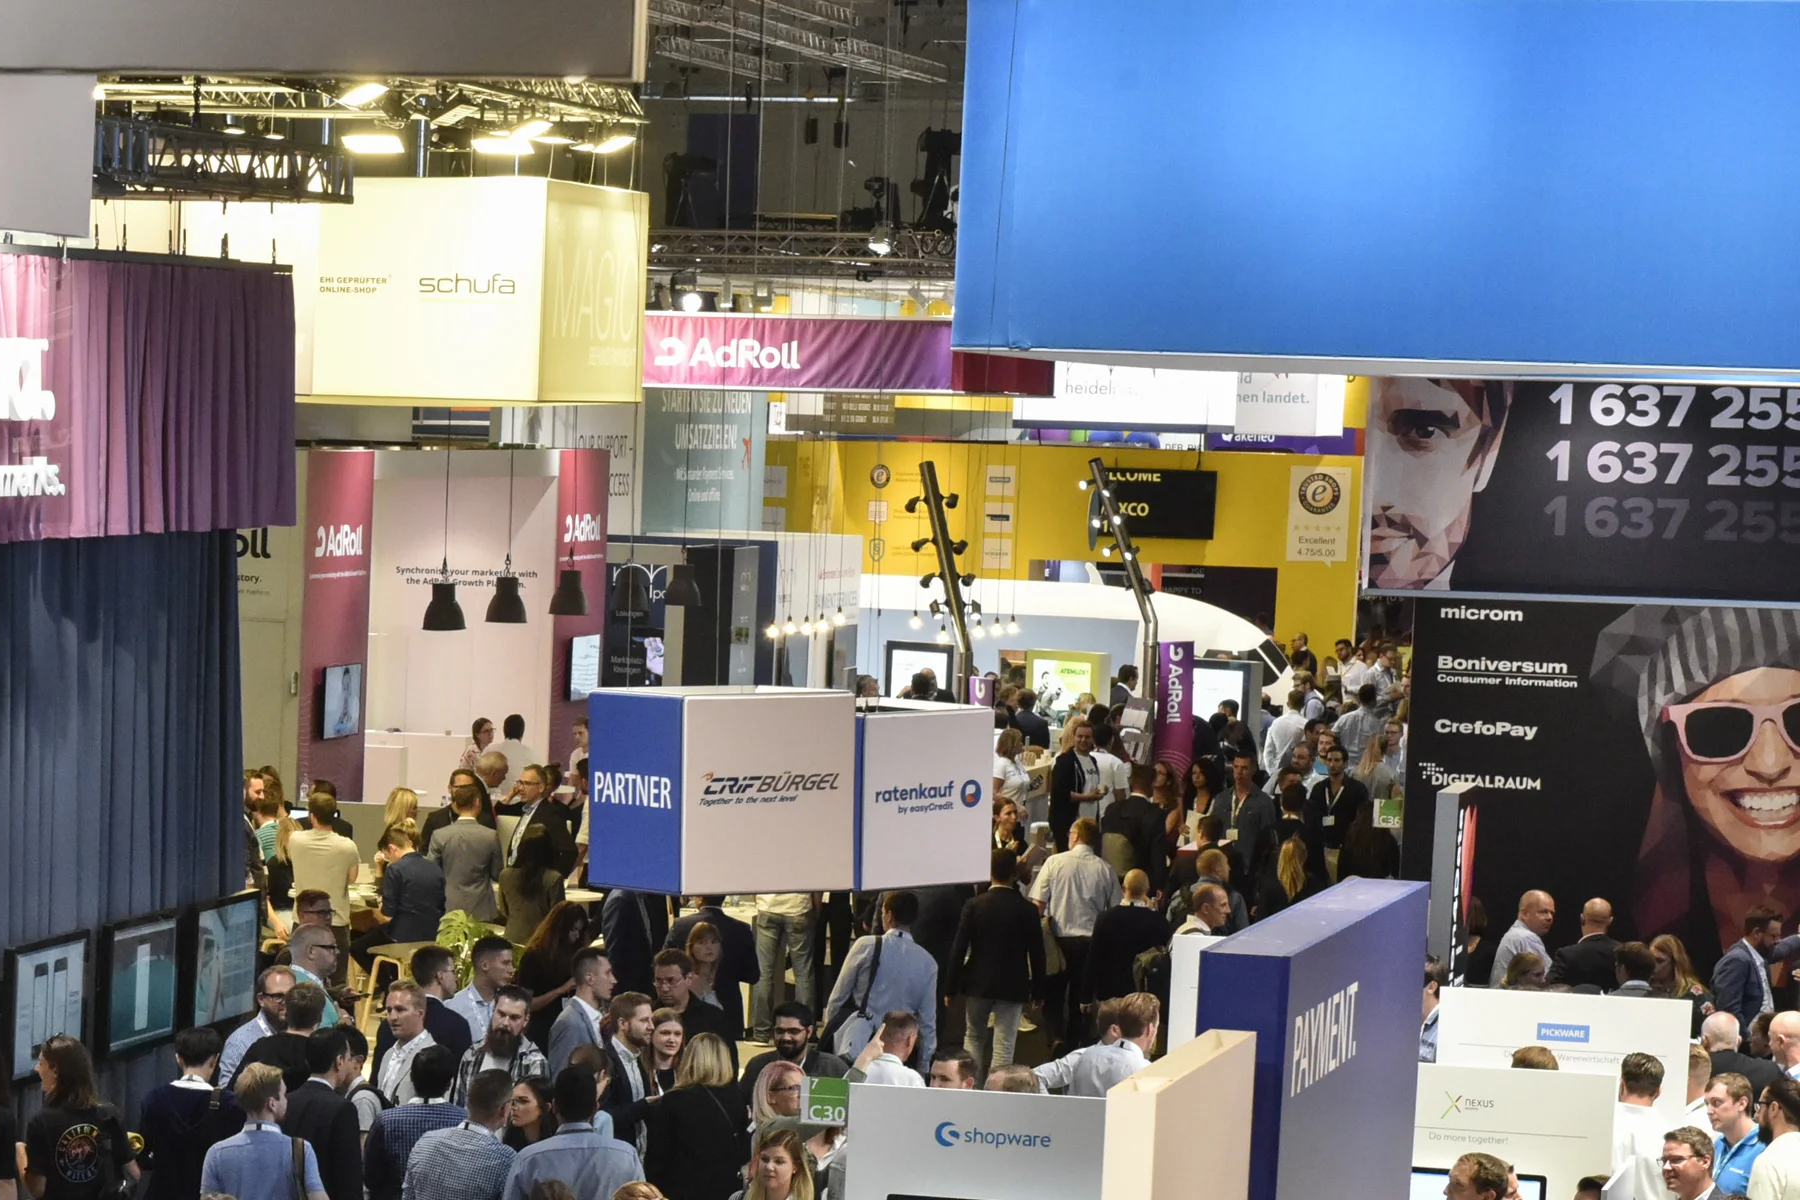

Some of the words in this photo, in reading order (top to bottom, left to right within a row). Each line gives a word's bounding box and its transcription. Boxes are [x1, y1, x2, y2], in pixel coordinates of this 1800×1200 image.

[319, 276, 334, 284] EHI
[419, 273, 516, 295] schufa
[319, 286, 377, 294] ONLINE-SHOP
[689, 336, 800, 370] AdRoll
[1262, 390, 1309, 404] landet.
[1549, 383, 1574, 425] 1
[1589, 384, 1696, 427] 637
[1545, 440, 1571, 481] 1
[1586, 441, 1693, 484] 637
[1543, 495, 1568, 536] 1
[1584, 496, 1690, 539] 637
[572, 513, 601, 542] AdRoll
[326, 524, 363, 557] AdRoll
[1298, 536, 1336, 546] Excellent
[449, 568, 469, 578] your
[518, 569, 538, 579] with
[406, 577, 420, 585] the
[452, 578, 484, 588] Growth
[1440, 606, 1523, 622] microm
[1437, 655, 1567, 674] Boniversum
[1437, 674, 1502, 685] Consumer
[1505, 677, 1578, 689] Information
[1166, 664, 1183, 724] AdRoll
[1434, 719, 1538, 741] CrefoPay
[594, 770, 672, 810] PARTNER
[875, 780, 954, 804] ratenkauf
[699, 795, 732, 807] Together
[735, 796, 744, 804] to
[746, 795, 758, 804] the
[760, 795, 777, 803] next
[779, 794, 798, 803] level
[898, 805, 908, 815] by
[910, 801, 954, 815] easyCredit
[1379, 814, 1401, 826] C36
[1290, 981, 1360, 1098] PAYMENT.
[1541, 1028, 1586, 1039] PICKWARE
[1558, 1053, 1620, 1064] Warenwirtschaft
[810, 1077, 820, 1090] 7
[808, 1105, 845, 1122] C30
[964, 1126, 1051, 1150] shopware
[1428, 1131, 1442, 1141] Do
[1443, 1134, 1466, 1143] more
[1468, 1134, 1509, 1146] together!
